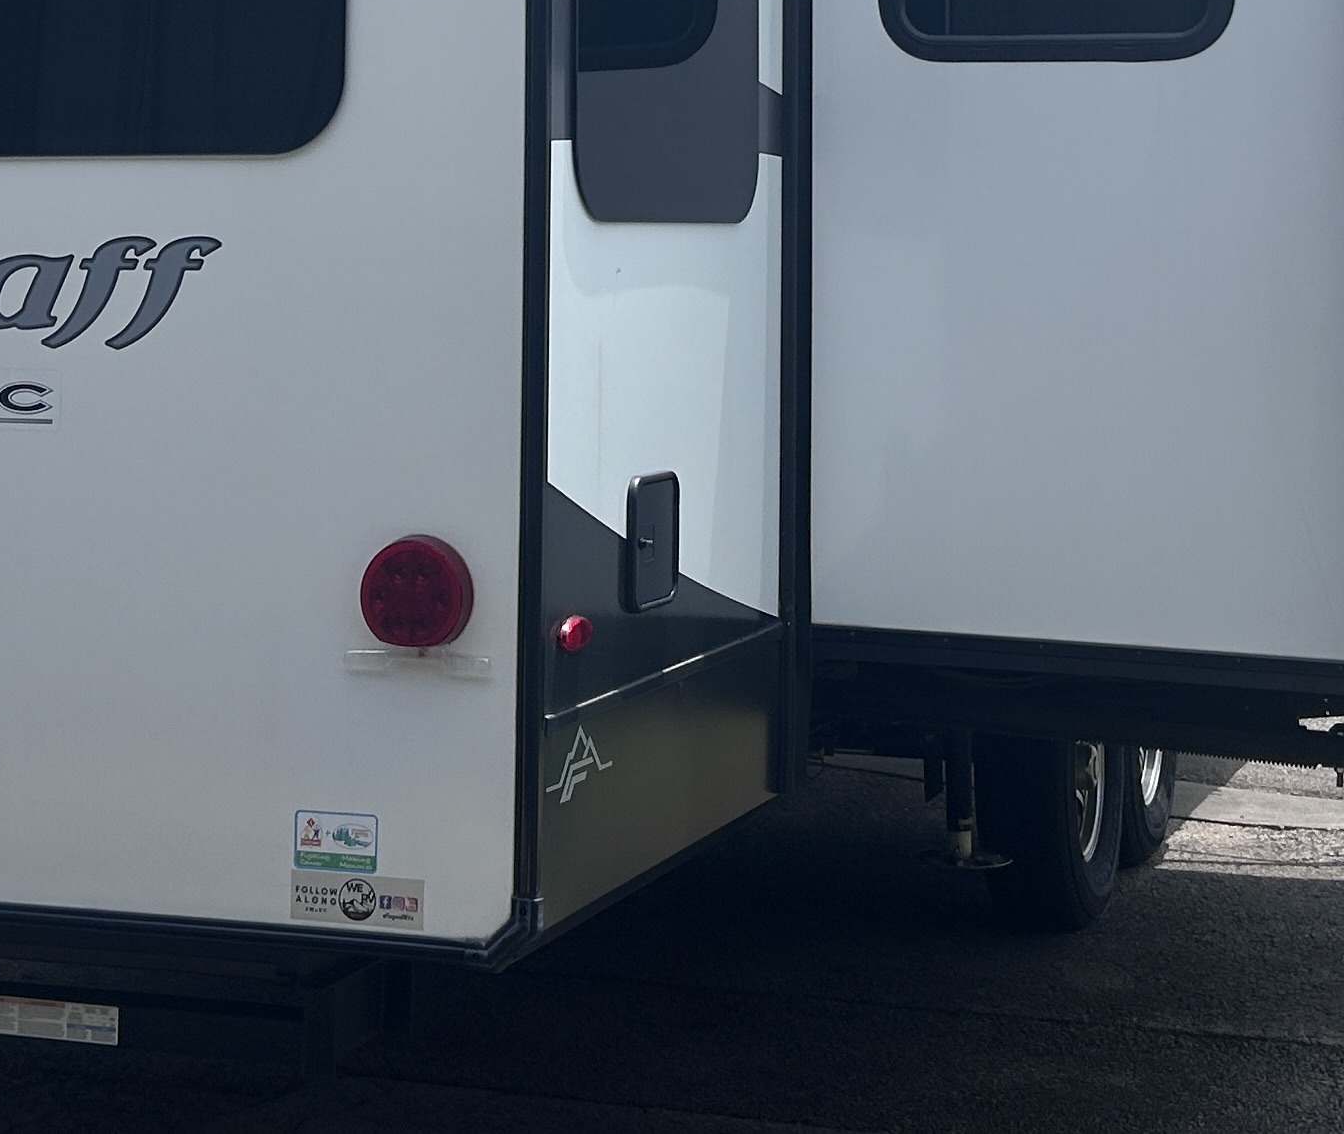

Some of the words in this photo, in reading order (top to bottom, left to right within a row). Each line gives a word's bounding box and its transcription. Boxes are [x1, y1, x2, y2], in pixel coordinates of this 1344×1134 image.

[295, 884, 338, 896] FOLLOW
[346, 882, 364, 893] WE
[295, 895, 337, 906] ALONG
